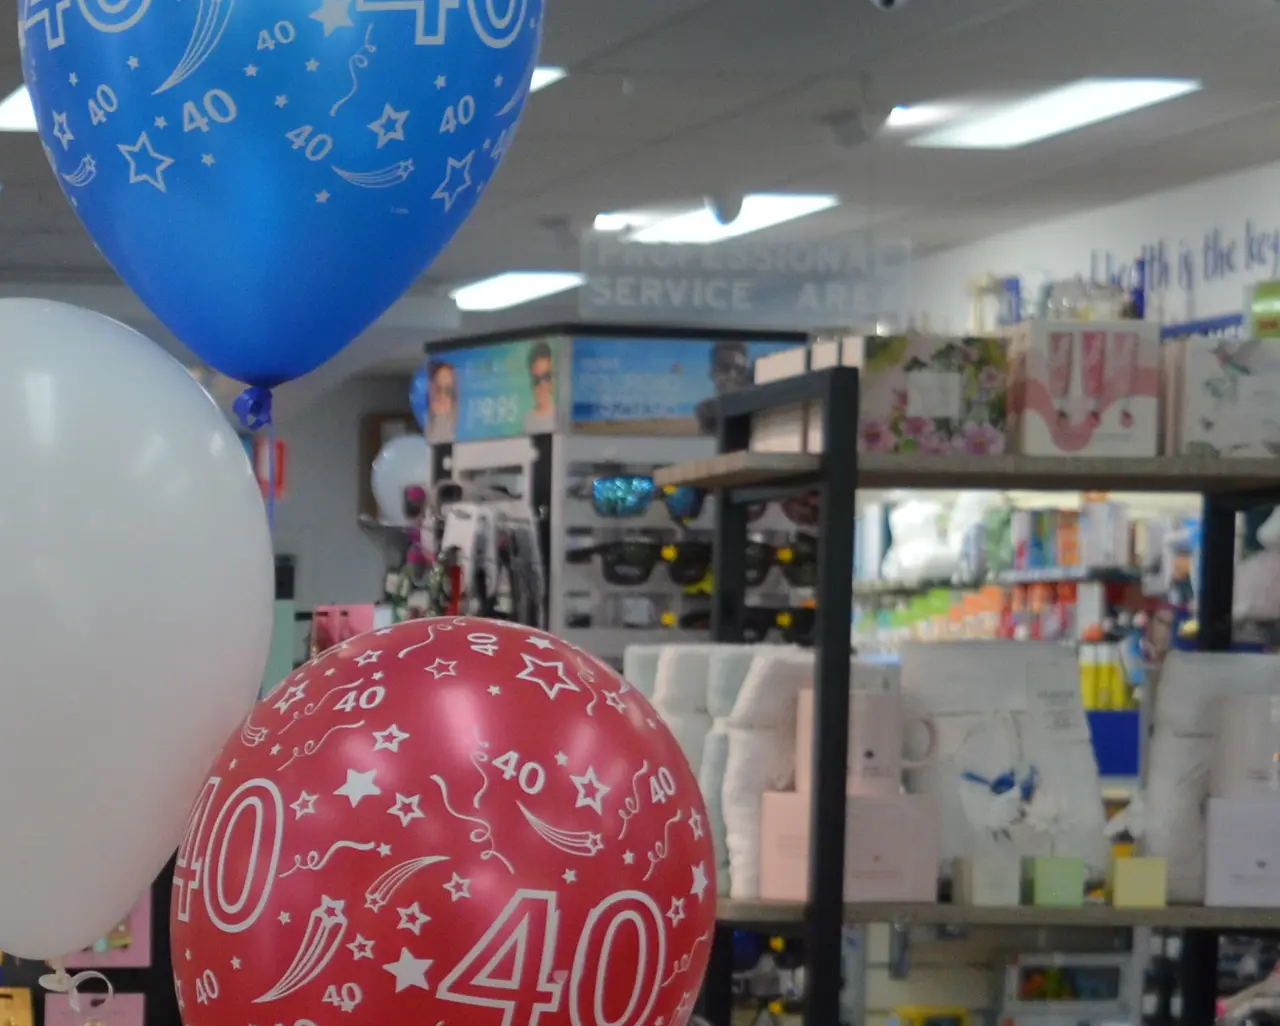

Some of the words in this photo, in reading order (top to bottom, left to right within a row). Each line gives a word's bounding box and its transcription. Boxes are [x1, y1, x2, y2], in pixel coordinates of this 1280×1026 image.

[255, 20, 296, 51] 40
[88, 84, 118, 126] 40
[182, 88, 237, 133] 40
[440, 95, 476, 135] 40
[285, 124, 333, 161] 40
[591, 276, 754, 312] SERVICE
[467, 632, 500, 657] 40
[333, 686, 387, 713] 40
[491, 750, 546, 795] 40
[649, 766, 676, 804] 40
[172, 776, 284, 933] 40
[195, 969, 219, 1005] 40
[322, 983, 363, 1007] 40
